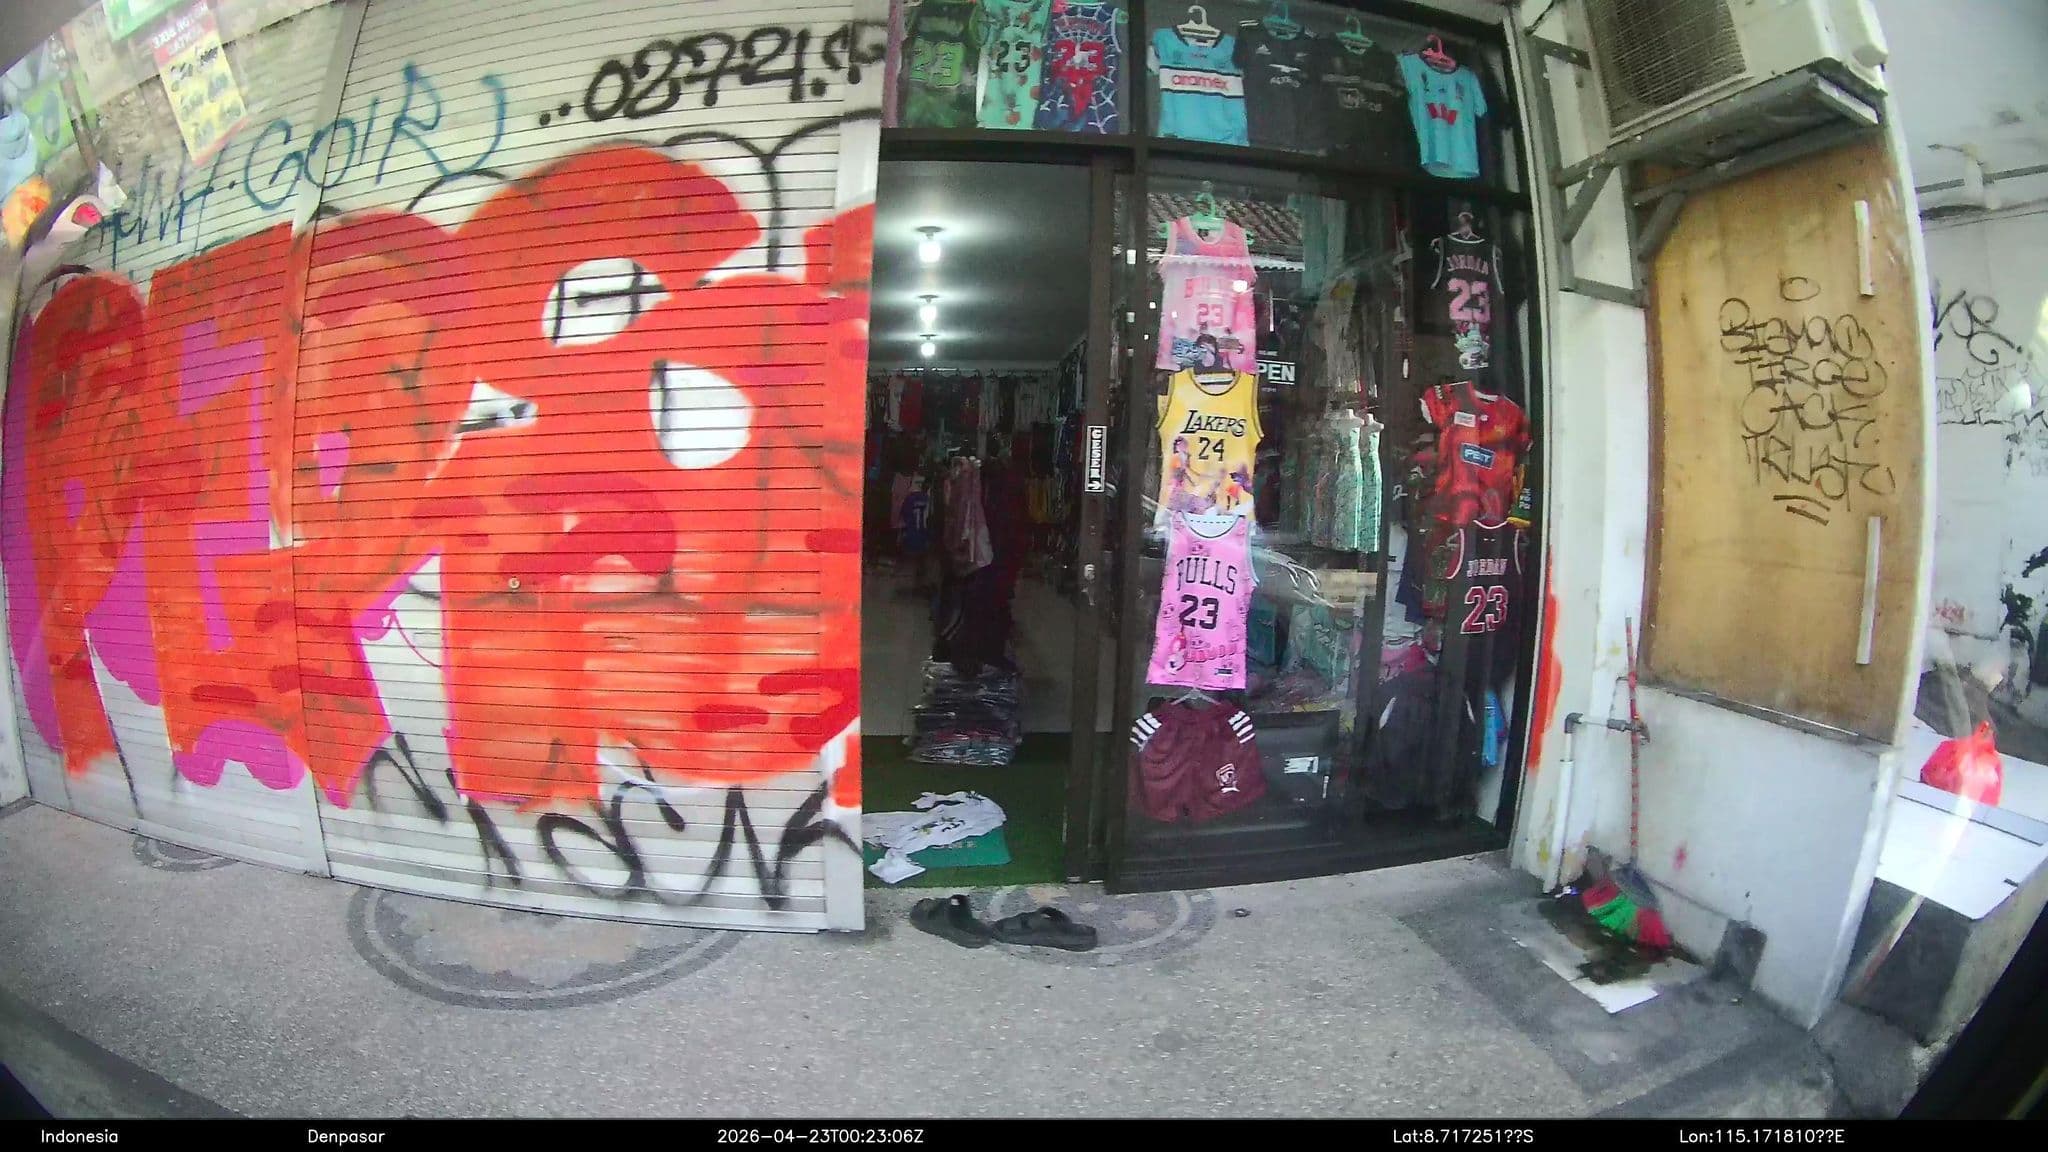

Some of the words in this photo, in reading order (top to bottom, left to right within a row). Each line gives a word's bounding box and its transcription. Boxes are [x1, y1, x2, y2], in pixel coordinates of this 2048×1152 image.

[910, 37, 966, 88] 23
[992, 40, 1032, 73] 23
[1050, 38, 1107, 78] 23
[1171, 73, 1230, 92] aramex
[1447, 277, 1491, 322] 23
[1197, 303, 1224, 327] 23
[1256, 362, 1296, 382] PEN
[1180, 410, 1247, 437] LAKERS
[1198, 437, 1225, 462] 24
[1466, 558, 1508, 577] JORDAN
[1179, 594, 1220, 630] 23
[1460, 585, 1509, 634] 23
